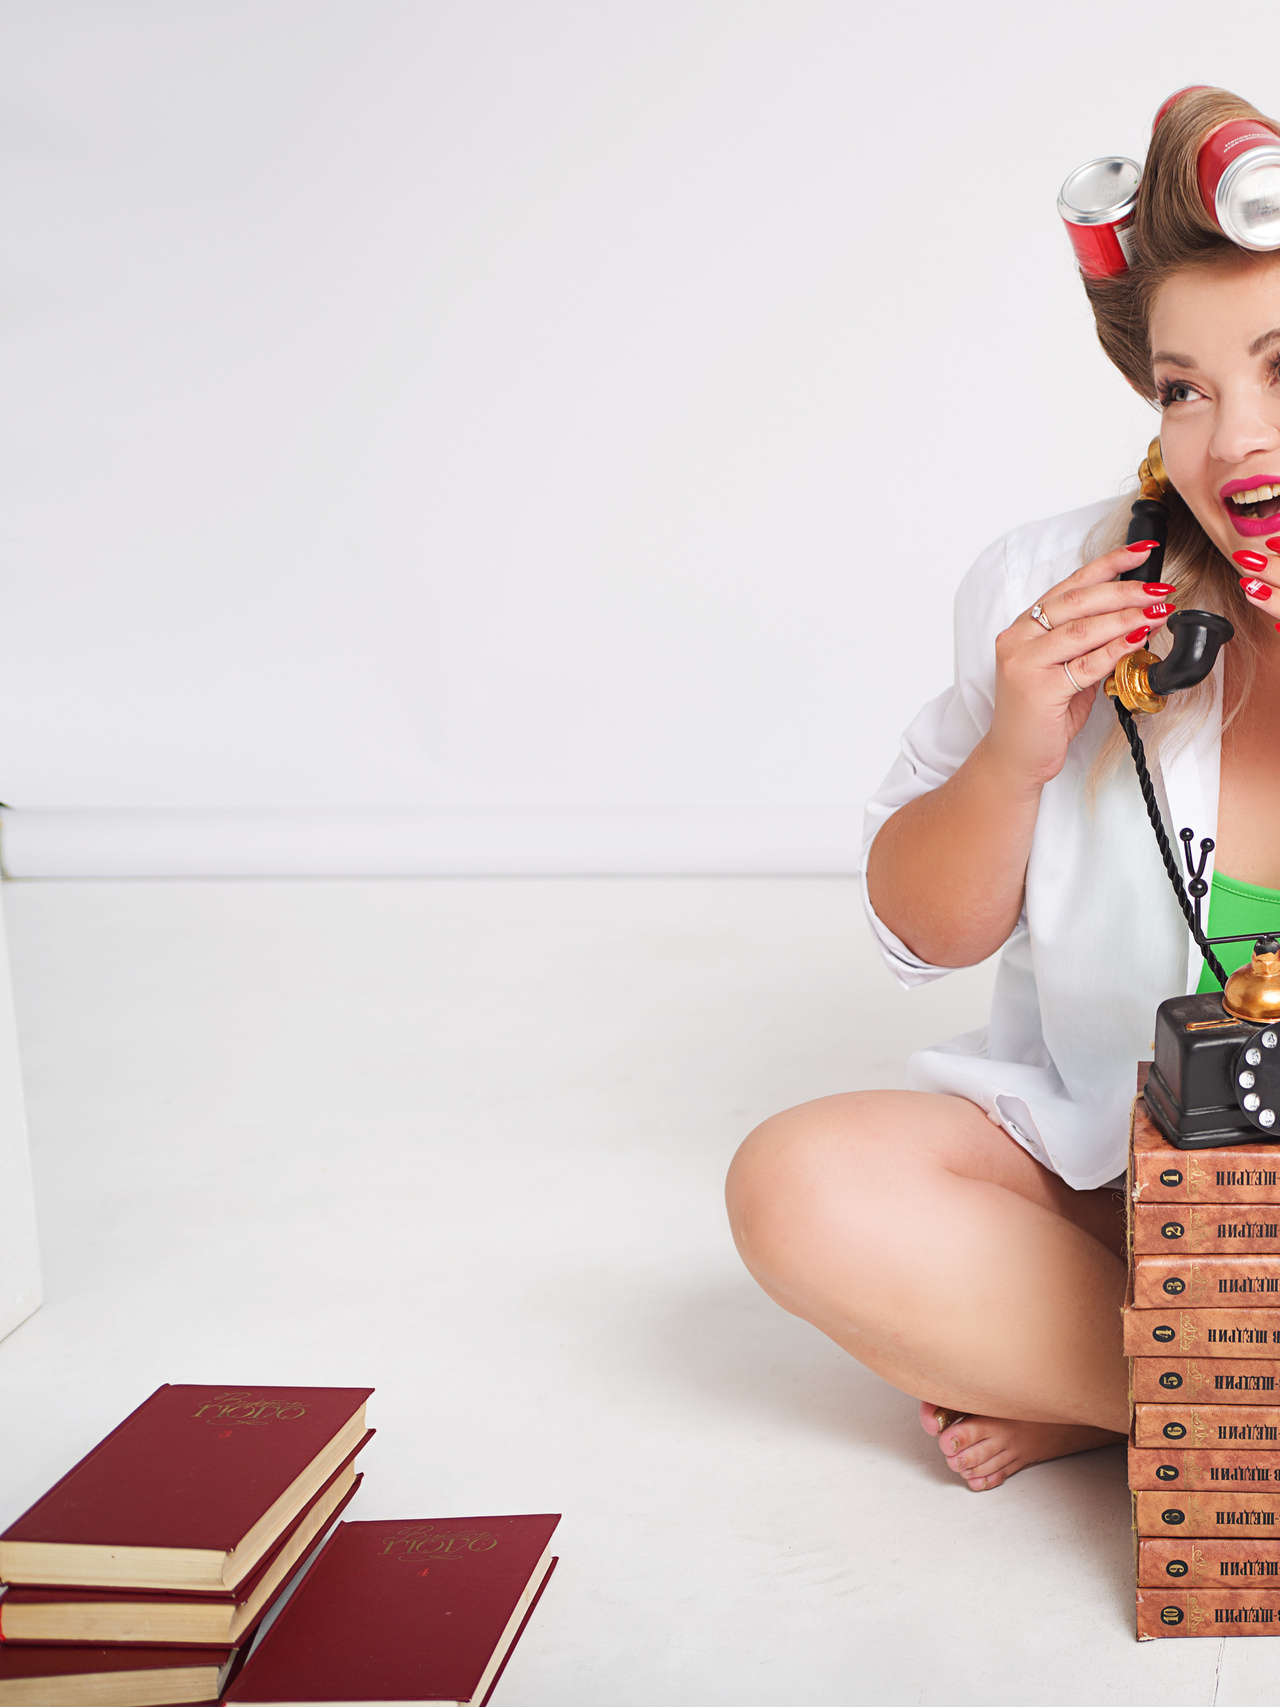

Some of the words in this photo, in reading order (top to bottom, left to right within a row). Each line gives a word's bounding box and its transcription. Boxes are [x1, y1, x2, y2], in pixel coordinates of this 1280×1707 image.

[1162, 1173, 1180, 1183] 1
[1165, 1225, 1182, 1236] 2
[1166, 1281, 1183, 1291] 3
[1155, 1329, 1172, 1339] 4
[1163, 1376, 1179, 1386] 5
[218, 1429, 233, 1438] 3
[1166, 1426, 1182, 1435] 6
[1159, 1468, 1176, 1477] 7
[416, 1567, 430, 1577] 4
[1169, 1564, 1185, 1573] 9
[1163, 1607, 1179, 1622] 10
